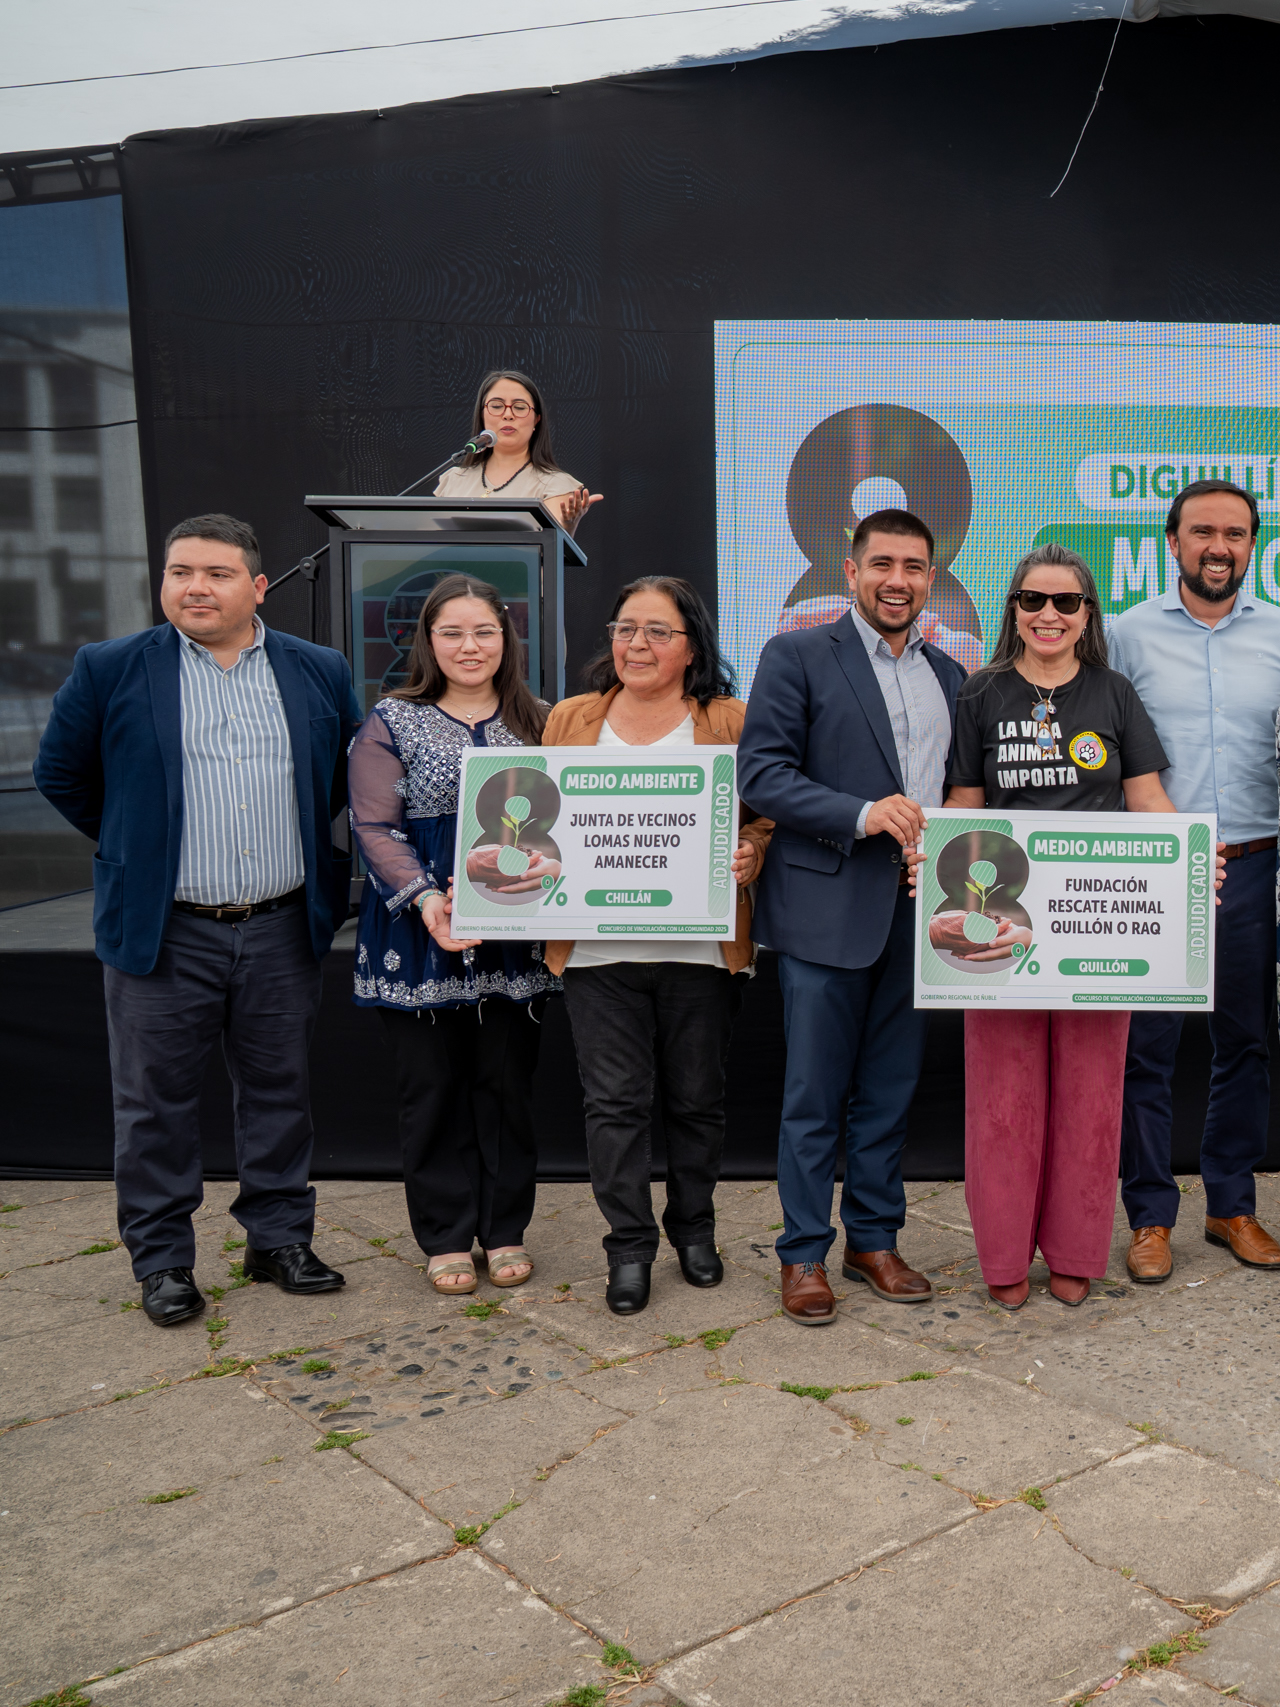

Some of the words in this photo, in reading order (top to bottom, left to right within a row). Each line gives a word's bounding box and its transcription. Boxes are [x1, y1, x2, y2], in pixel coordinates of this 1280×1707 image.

[998, 721, 1018, 740] LA
[1021, 721, 1062, 739] VIDA
[566, 773, 617, 789] MEDIO
[620, 773, 698, 789] AMBIENTE
[997, 766, 1079, 789] IMPORTA
[570, 814, 615, 827] JUNTA
[617, 814, 634, 827] DE
[637, 813, 697, 827] VECINOS
[584, 834, 630, 848] LOMAS
[634, 834, 681, 847] NUEVO
[712, 782, 731, 889] ADJUDICADO
[1034, 839, 1088, 856] MEDIO
[1091, 840, 1173, 857] AMBIENTE
[594, 855, 668, 869] AMANECER
[1066, 876, 1148, 893] FUNDACIÓN
[605, 890, 652, 904] CHILLÁN
[1190, 851, 1207, 959] ADJUDICADO
[1048, 899, 1107, 913] RESCATE
[1111, 900, 1164, 914] ANIMAL
[1051, 918, 1113, 935] QUILLÓN
[1117, 921, 1128, 934] O
[1132, 921, 1161, 936] RAQ
[1079, 959, 1129, 974] QUILLÓN
